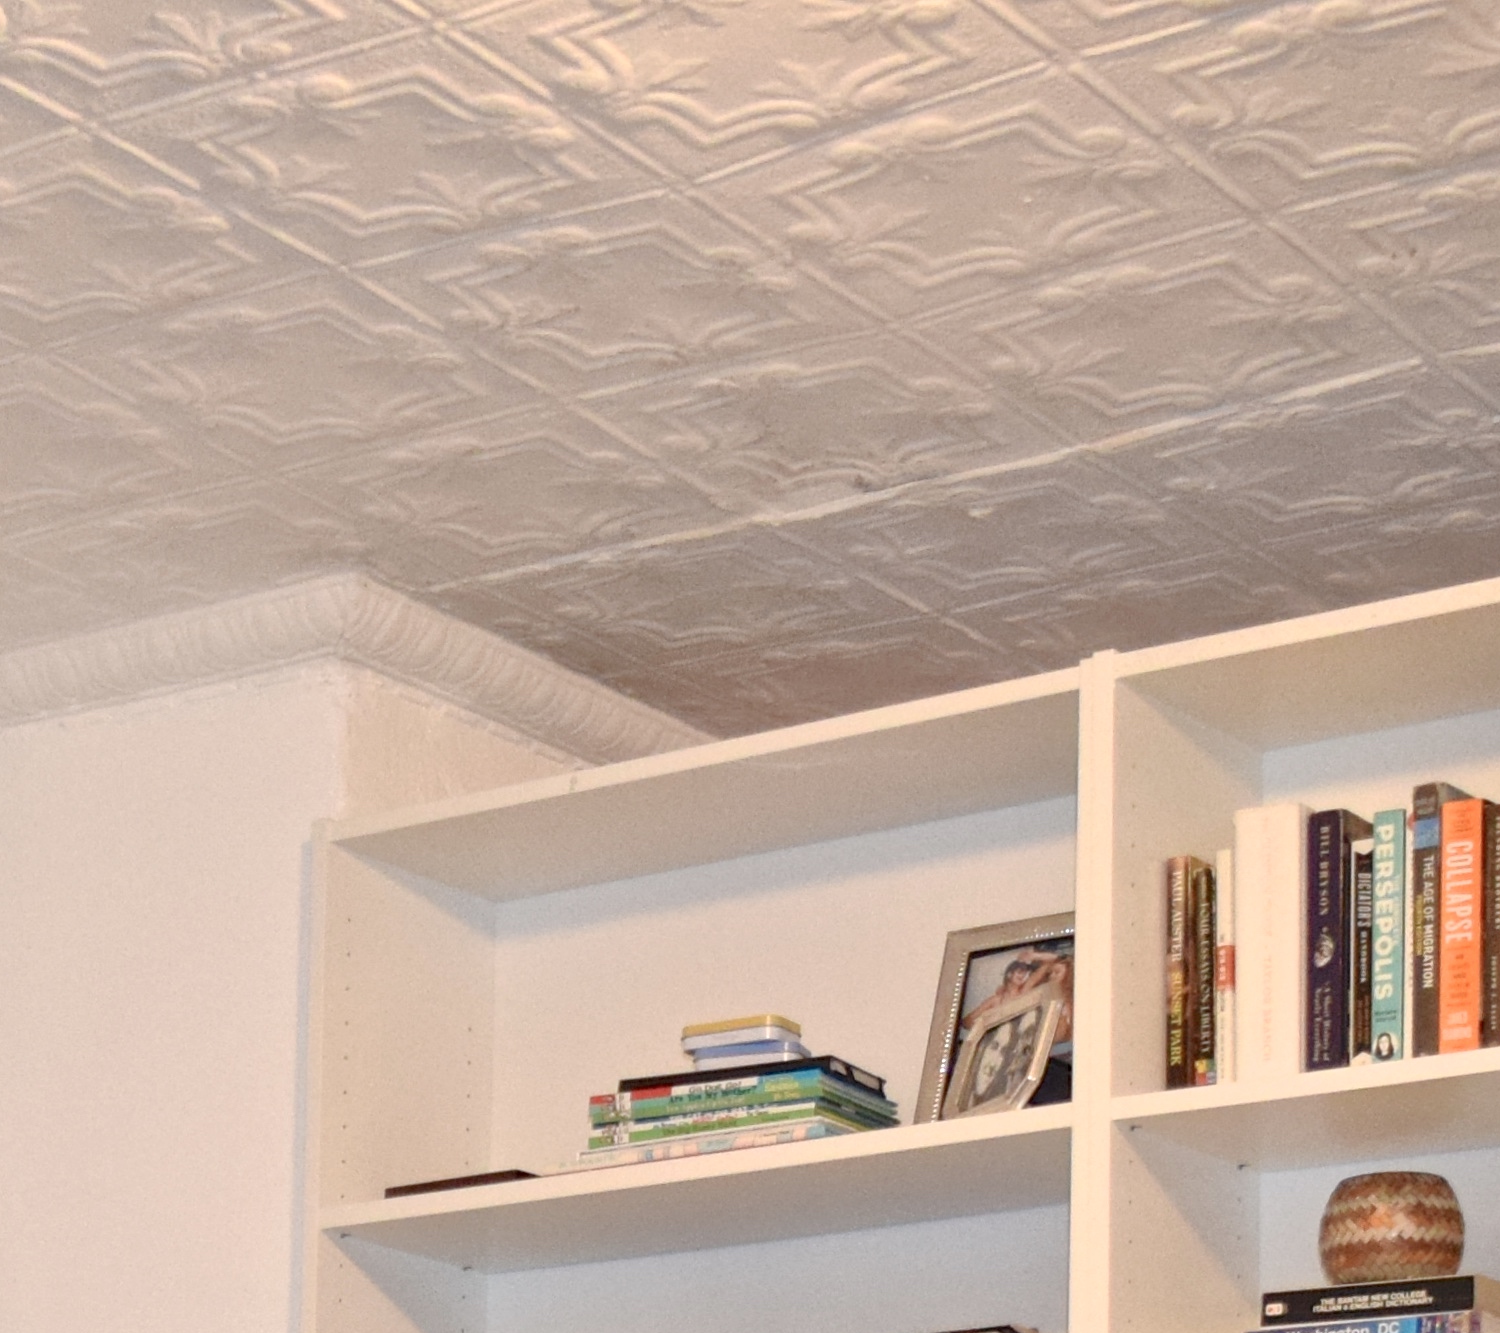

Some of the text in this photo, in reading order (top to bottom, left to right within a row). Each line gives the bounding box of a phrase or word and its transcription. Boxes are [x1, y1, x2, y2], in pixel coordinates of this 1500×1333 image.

[1171, 869, 1185, 962] PAUL AUSTER
[1319, 861, 1330, 916] BRYSON
[1374, 824, 1396, 1000] PERSEPOLIS
[1422, 856, 1435, 989] THE AGE OF MIGRATION
[1444, 841, 1474, 944] COLLAPSE
[1169, 971, 1184, 1066] SUNSET PARK
[1200, 1005, 1212, 1054] LIBERTY
[1320, 1297, 1335, 1306] THE
[1371, 1293, 1389, 1303] NEW
[1390, 1290, 1427, 1300] COLLEGE
